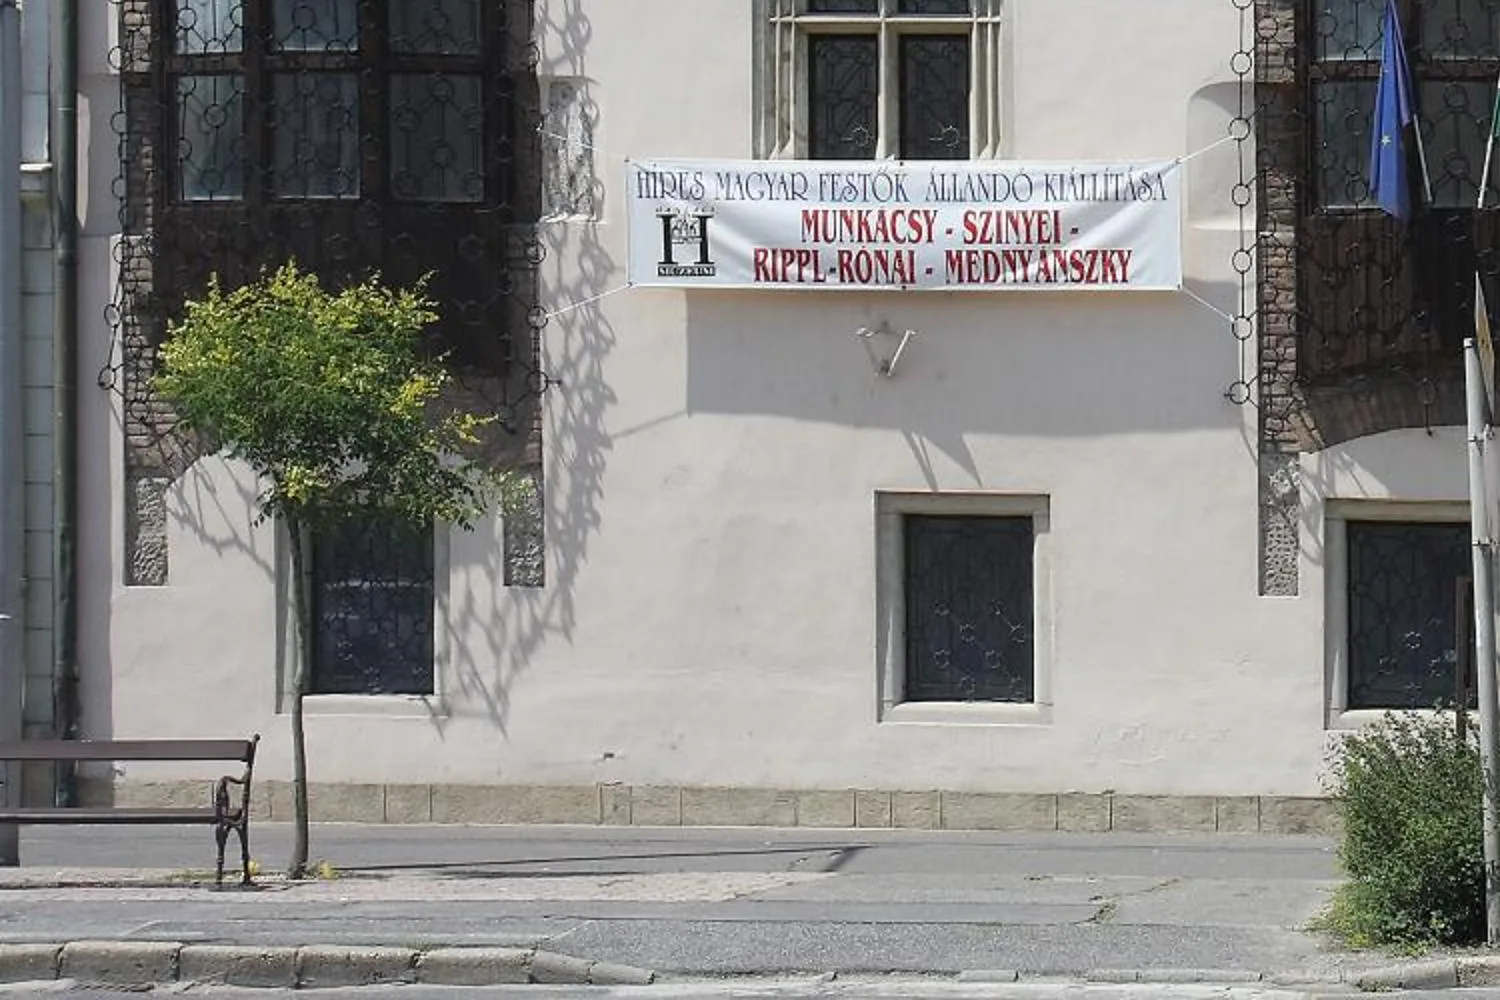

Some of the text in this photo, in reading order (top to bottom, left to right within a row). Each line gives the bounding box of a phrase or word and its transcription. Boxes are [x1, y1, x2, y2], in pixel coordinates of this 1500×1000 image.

[715, 171, 809, 201] MAGYAR
[819, 166, 911, 202] FESTŐK
[925, 168, 1034, 203] ÁLLANDÓ
[1044, 166, 1168, 203] KIÁLLÍTÁSA
[963, 209, 1063, 245] SZINYEI
[945, 246, 1133, 284] MEDNYÁNSZKY
